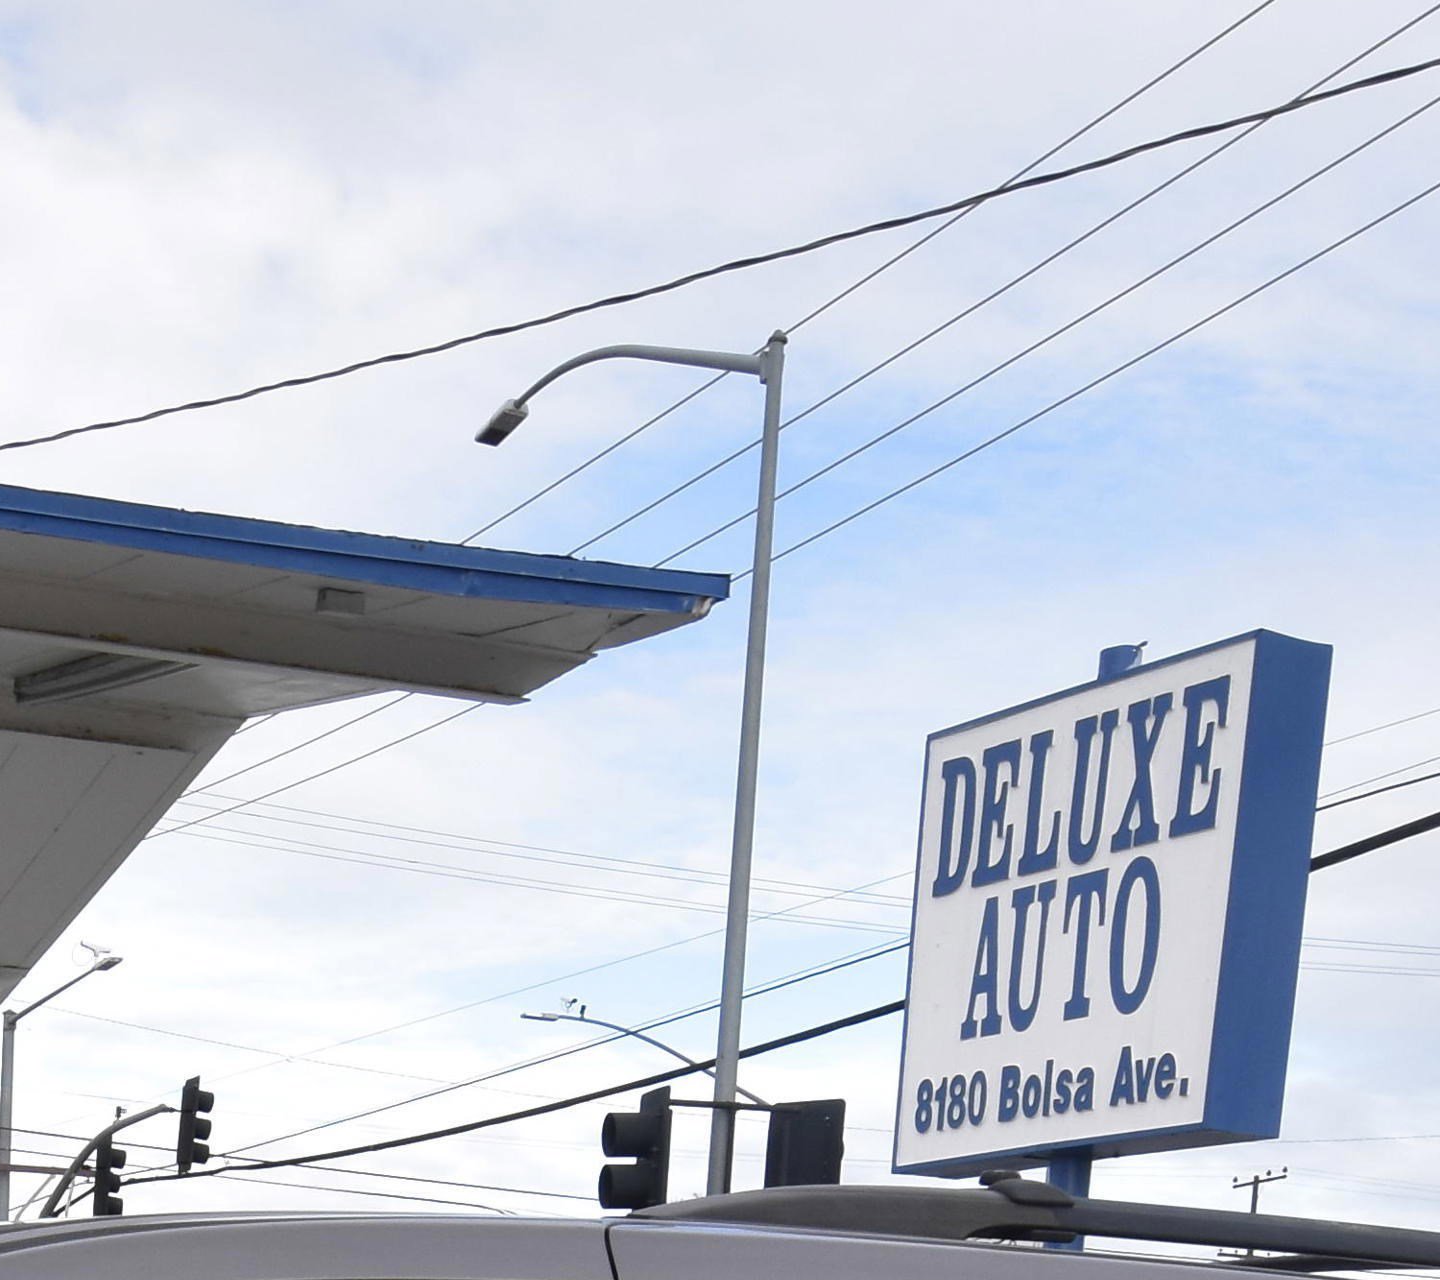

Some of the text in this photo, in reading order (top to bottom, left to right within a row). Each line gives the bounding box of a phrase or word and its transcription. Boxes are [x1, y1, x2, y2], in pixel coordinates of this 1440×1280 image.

[932, 674, 1231, 898] DELUXE
[960, 856, 1161, 1040] AUTO
[914, 1046, 1189, 1134] 8180 Bolsa Ave.
